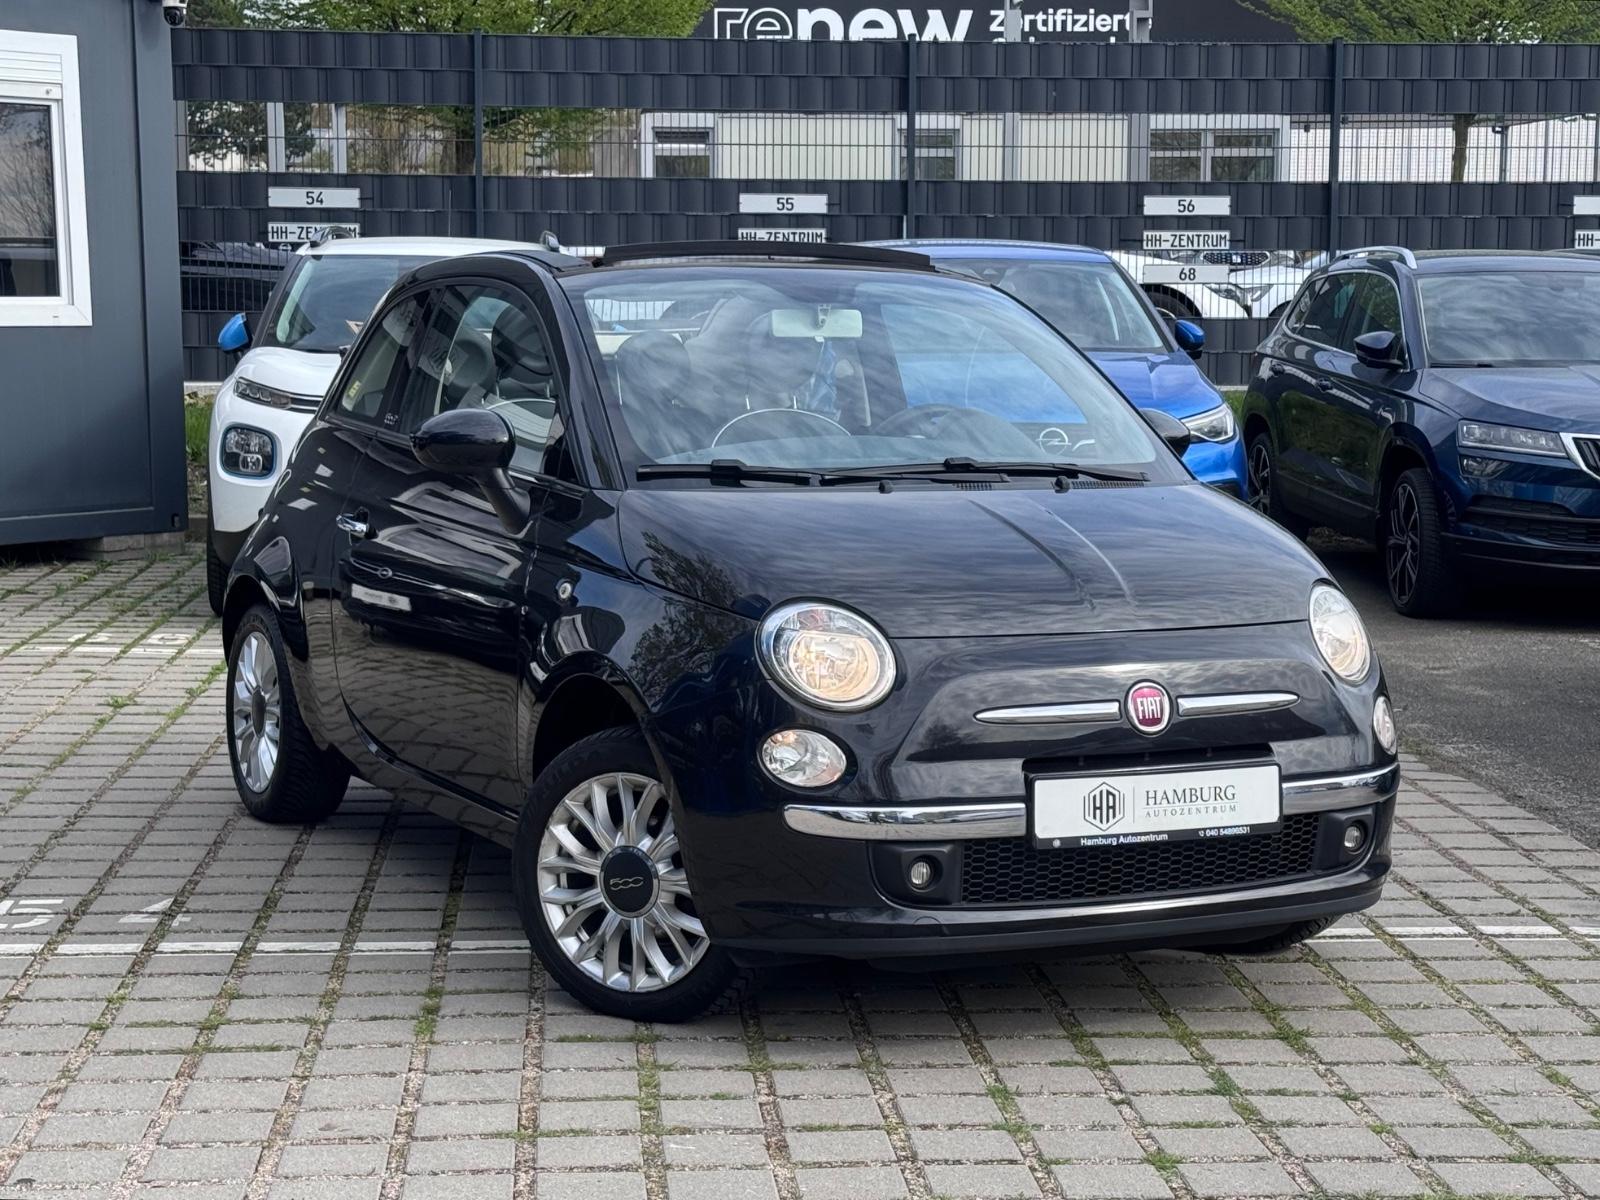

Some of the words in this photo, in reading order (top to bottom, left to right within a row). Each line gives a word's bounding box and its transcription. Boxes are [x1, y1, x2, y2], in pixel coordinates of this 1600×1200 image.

[713, 7, 974, 41] renew
[989, 8, 1152, 32] Zrtifiziert
[305, 191, 324, 205] 54
[776, 197, 794, 211] 55
[1177, 199, 1195, 213] 56
[741, 231, 823, 242] HH-ZENTRUM
[1145, 234, 1227, 247] HH-ZENTRUM
[1179, 267, 1196, 281] 68
[1136, 696, 1161, 720] FIAT
[1145, 784, 1236, 806] HAMBURG
[1145, 804, 1237, 818] AUTOZENTRUM
[1080, 836, 1117, 846] Hamburg
[1118, 833, 1168, 844] Autozentrum
